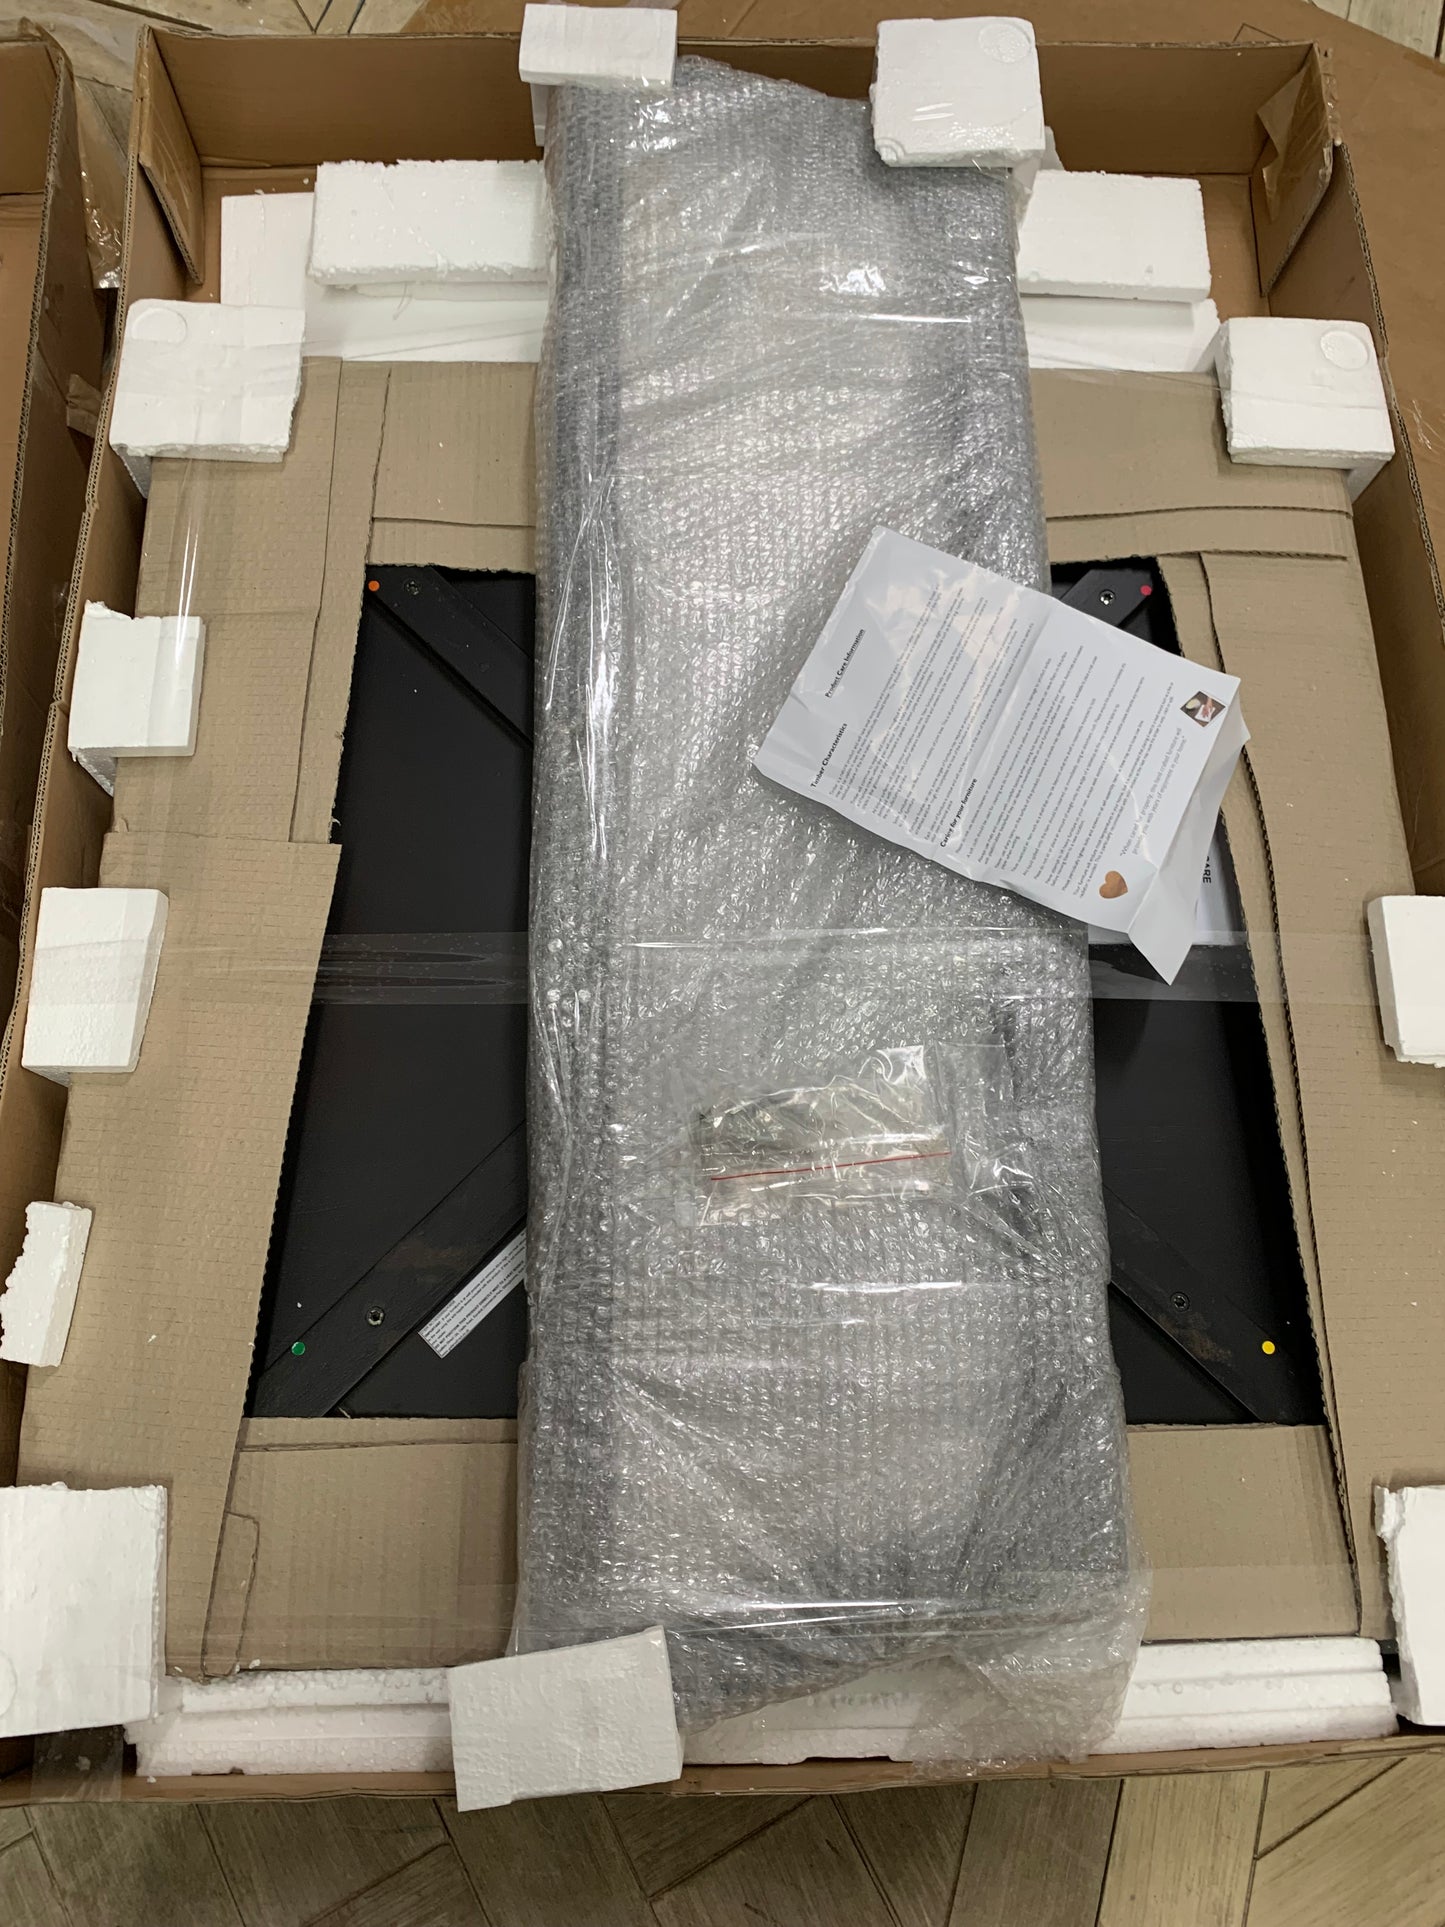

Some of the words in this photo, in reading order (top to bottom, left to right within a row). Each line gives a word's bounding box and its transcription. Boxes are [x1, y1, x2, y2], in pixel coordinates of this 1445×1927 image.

[825, 675, 840, 698] Product
[837, 662, 848, 676] Care
[844, 629, 865, 662] Information
[811, 765, 825, 788] Timber
[823, 723, 848, 766] Characteristics
[955, 804, 966, 819] your
[961, 778, 978, 804] furniture
